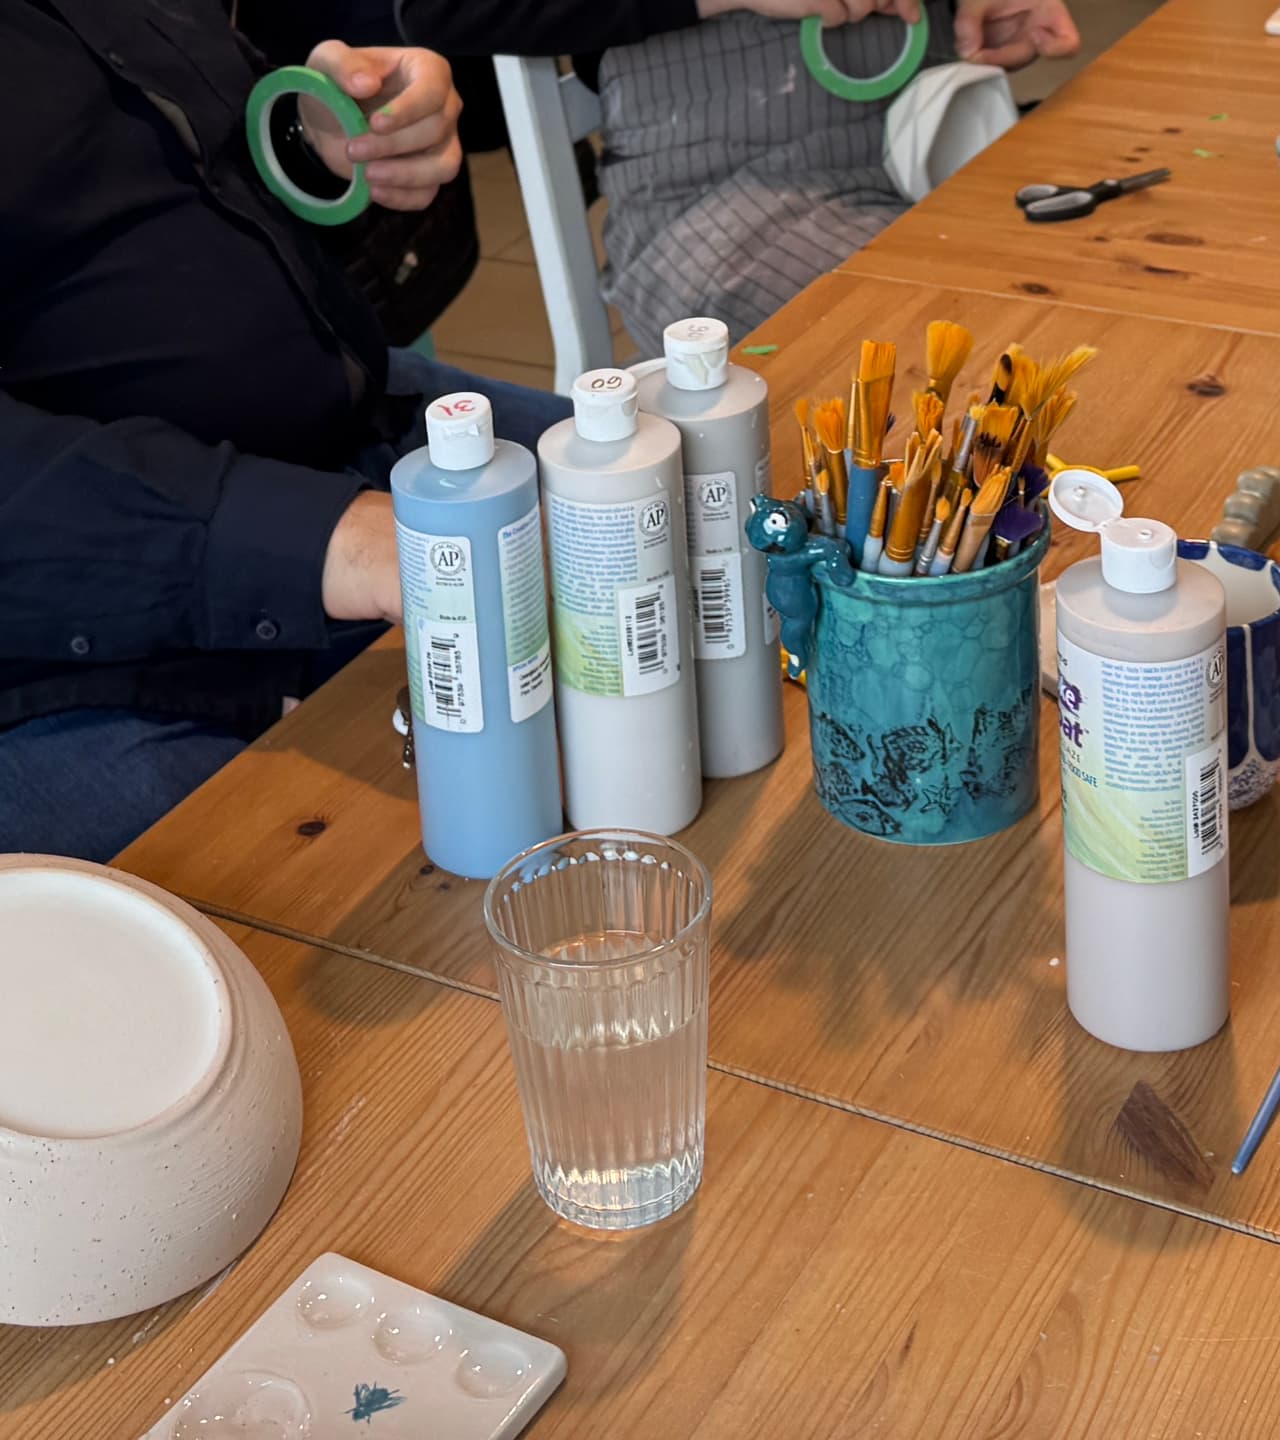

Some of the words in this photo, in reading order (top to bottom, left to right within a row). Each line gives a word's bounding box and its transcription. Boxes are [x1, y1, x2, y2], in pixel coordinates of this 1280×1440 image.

[705, 486, 726, 504] AP
[646, 508, 665, 529] AP
[438, 550, 460, 567] AP
